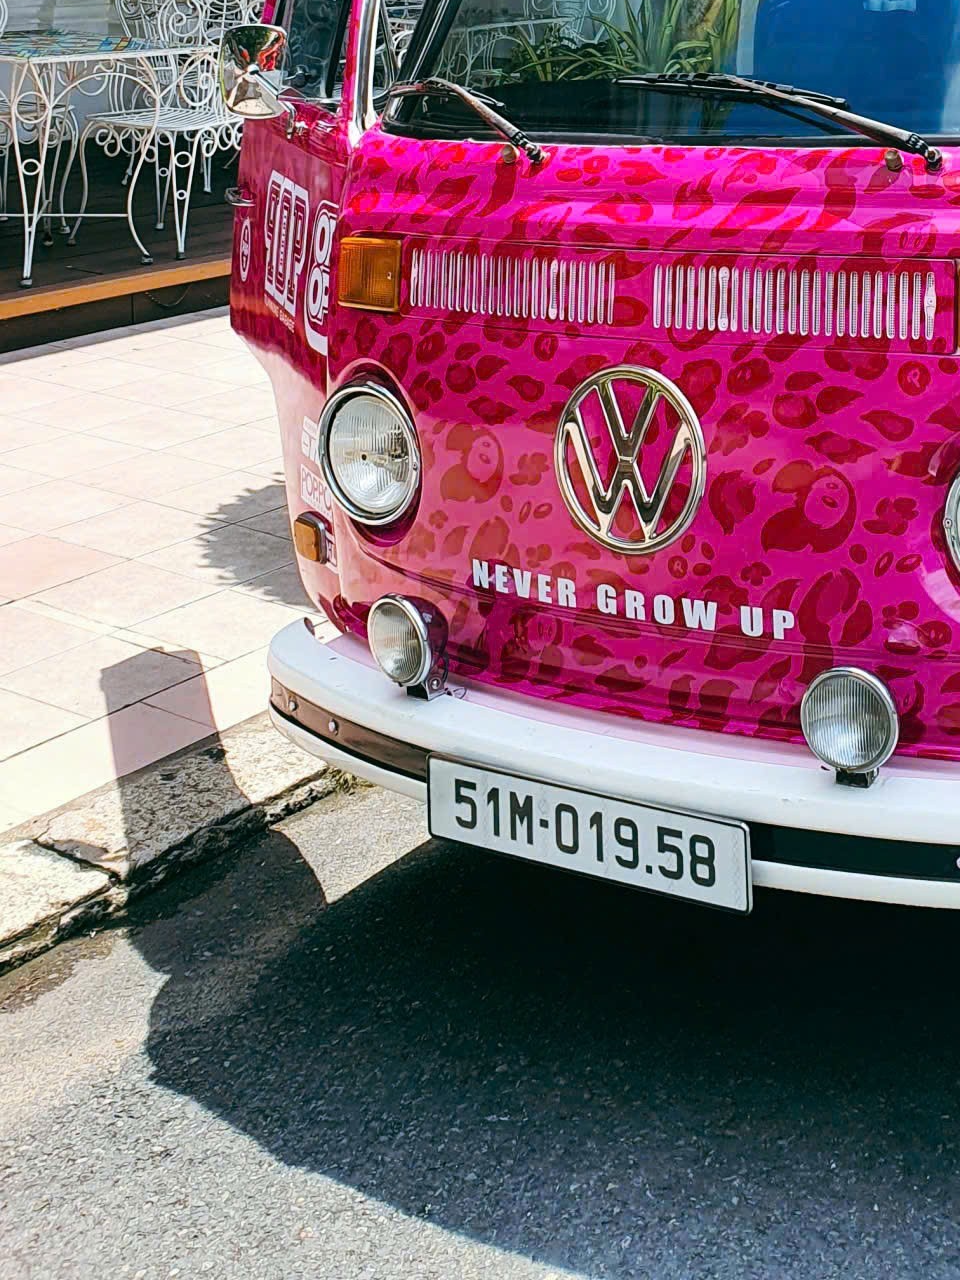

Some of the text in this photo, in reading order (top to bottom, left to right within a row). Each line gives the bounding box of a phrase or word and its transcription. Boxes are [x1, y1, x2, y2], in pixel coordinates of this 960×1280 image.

[472, 558, 796, 640] NEVER GROW UP
[454, 778, 716, 888] 51M-019.58
